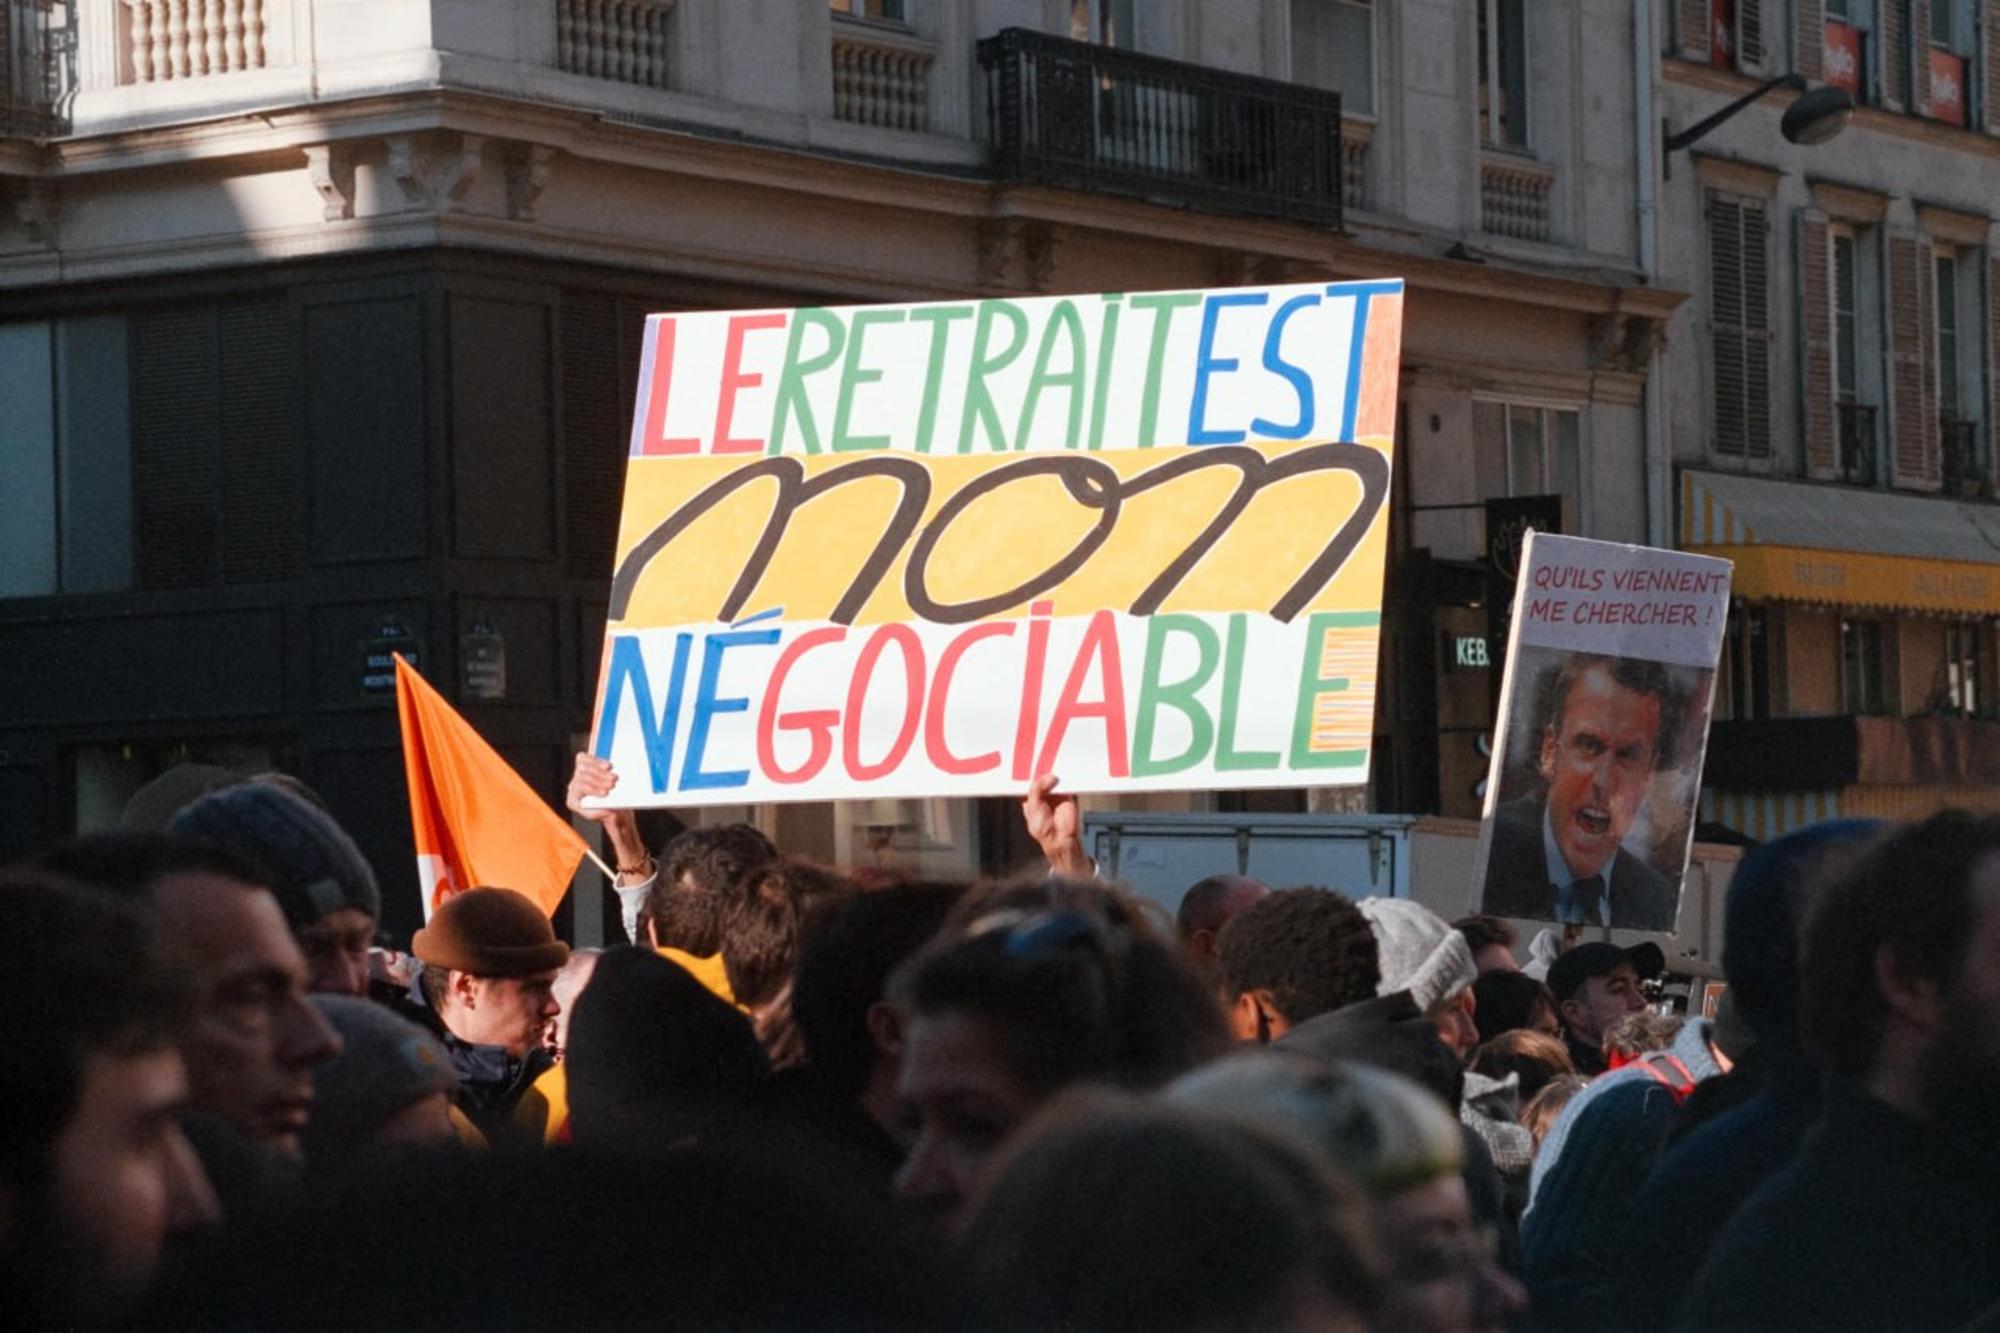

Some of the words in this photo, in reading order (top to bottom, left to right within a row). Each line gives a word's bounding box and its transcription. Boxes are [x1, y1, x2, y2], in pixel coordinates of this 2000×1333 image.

[1535, 565, 1605, 592] QU'ILS
[1612, 569, 1726, 595] VIENNENT
[1529, 598, 1568, 623] ME
[1573, 601, 1698, 627] CHERCHER
[1456, 637, 1490, 666] KEB
[594, 599, 1381, 793] NÉGOCIABLE
